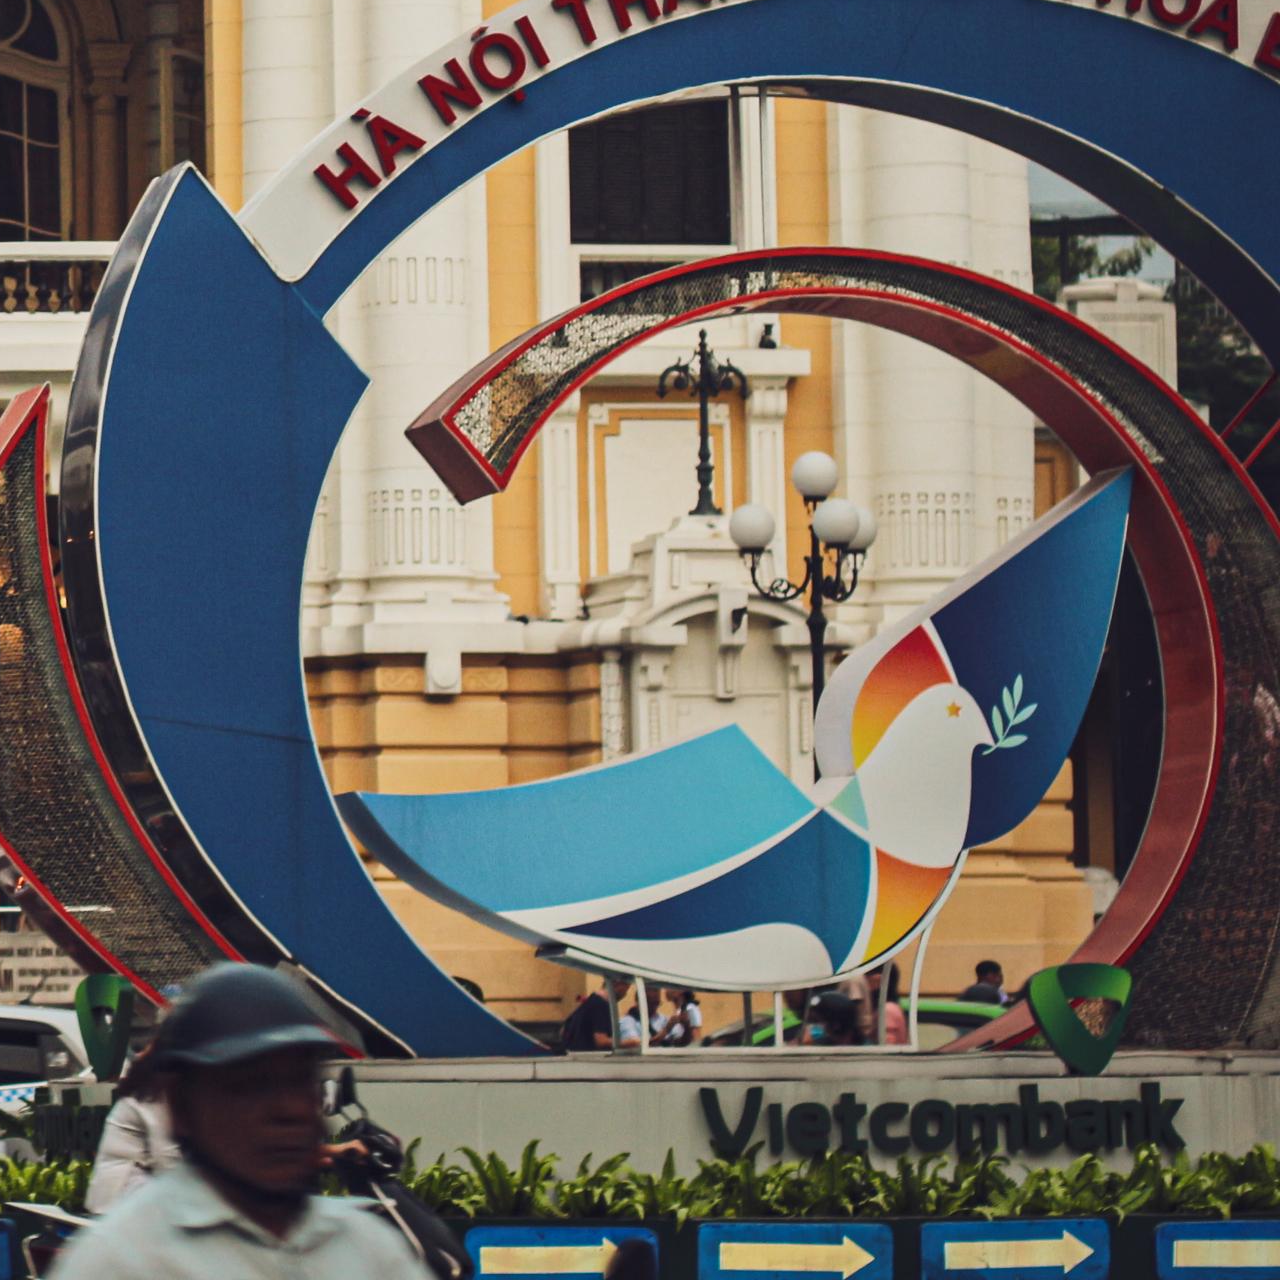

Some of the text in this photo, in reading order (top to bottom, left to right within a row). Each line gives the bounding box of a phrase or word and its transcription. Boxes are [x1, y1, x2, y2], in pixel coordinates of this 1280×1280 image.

[313, 108, 427, 211] HÀ
[417, 15, 551, 126] NỘI
[699, 1081, 1185, 1156] Vietcombank
